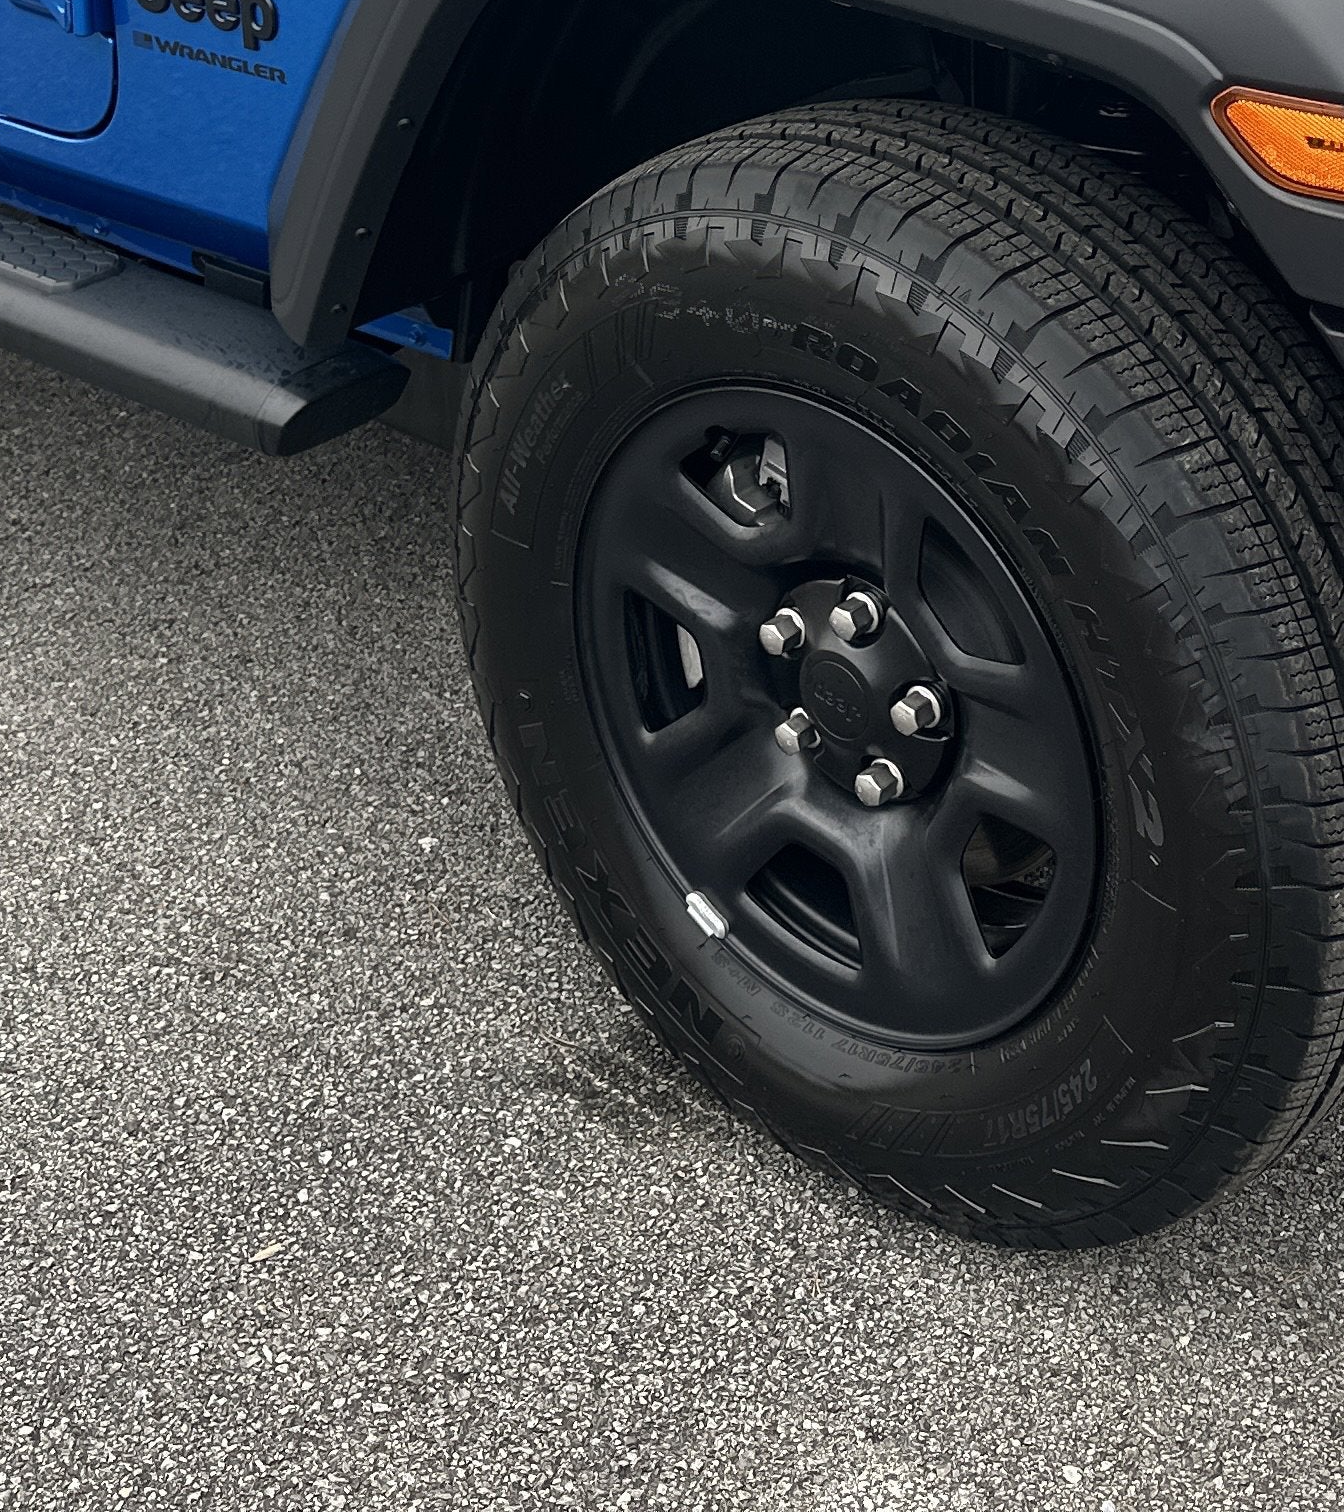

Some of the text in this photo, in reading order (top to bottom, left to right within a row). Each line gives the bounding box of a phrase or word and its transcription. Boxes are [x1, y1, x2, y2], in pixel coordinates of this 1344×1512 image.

[154, 36, 288, 86] WRANGLER
[792, 320, 1080, 577] ROADIAN
[517, 721, 725, 1047] NEXEN
